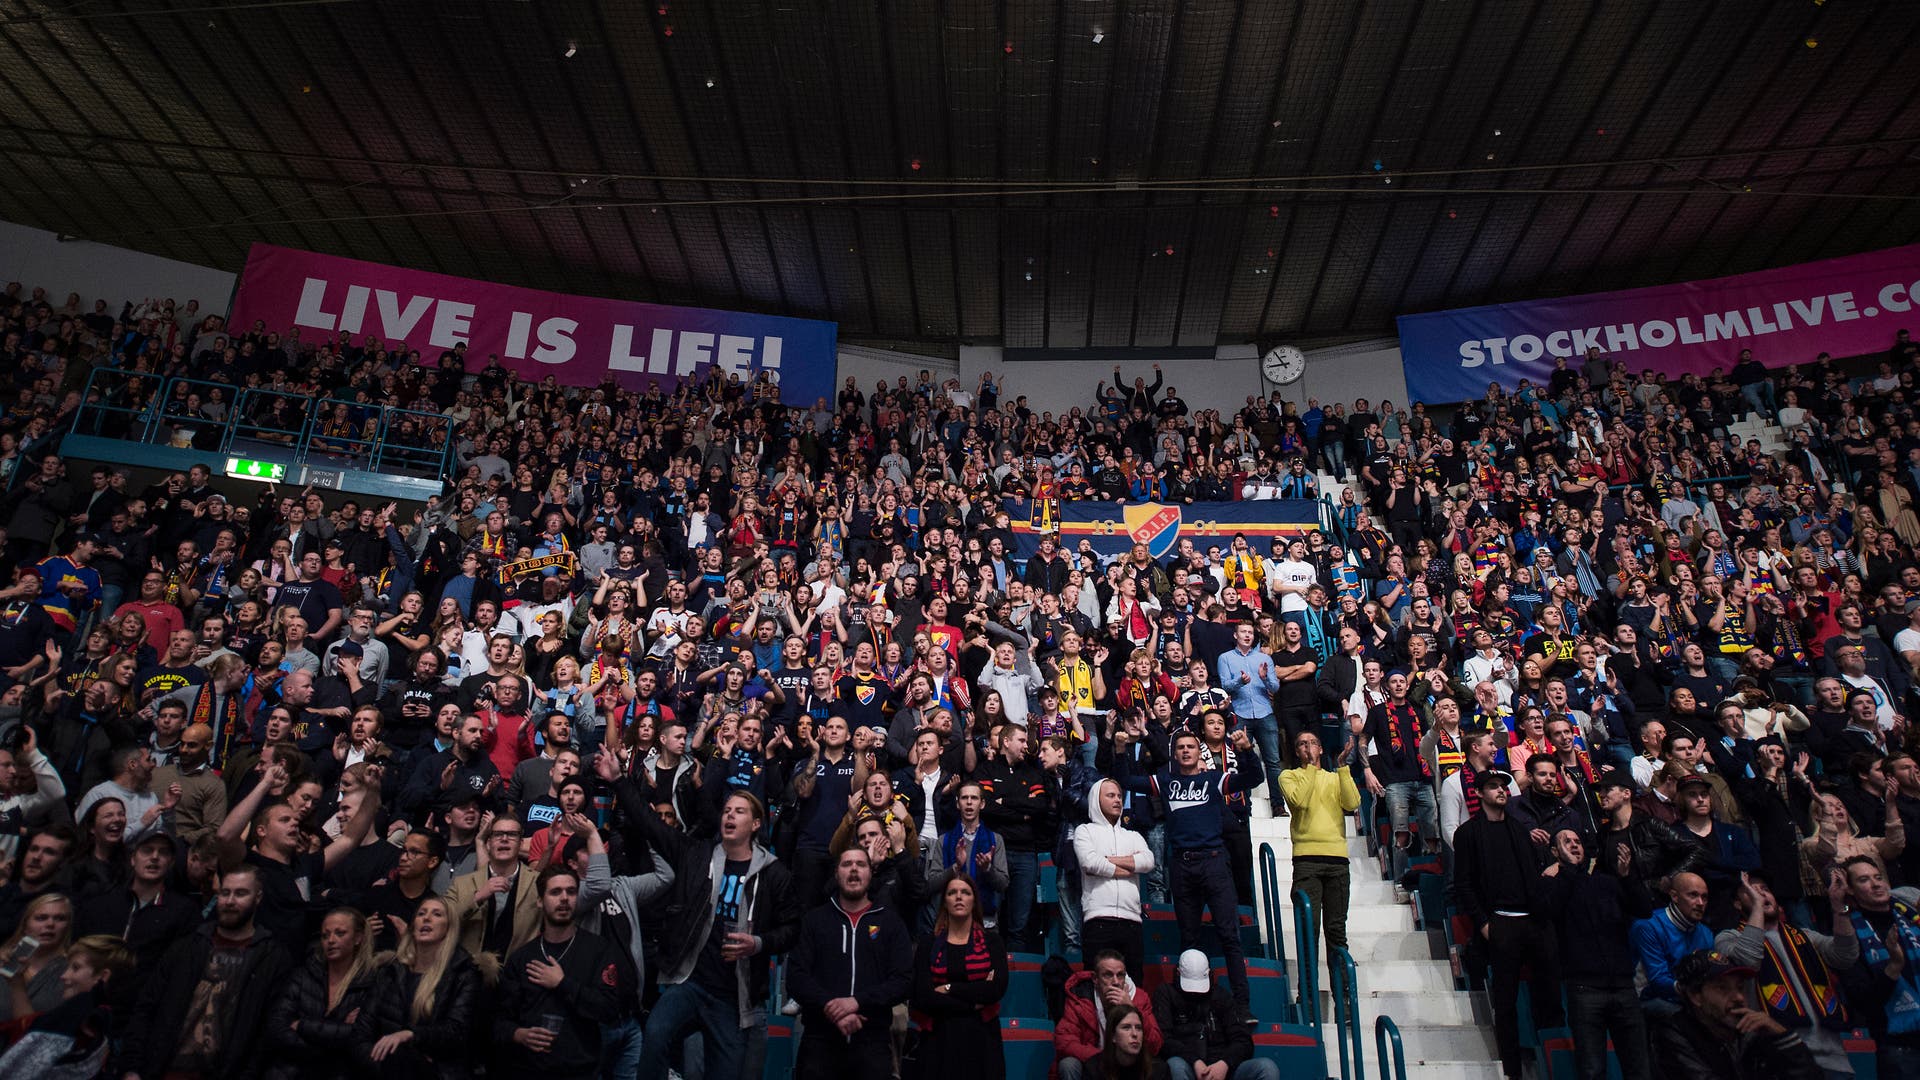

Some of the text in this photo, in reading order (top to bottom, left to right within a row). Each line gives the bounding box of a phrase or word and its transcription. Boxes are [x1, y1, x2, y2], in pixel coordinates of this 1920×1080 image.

[294, 277, 782, 384] LIVE IS LIFE!
[1091, 520, 1116, 536] 18
[1194, 520, 1220, 536] 91
[1545, 647, 1575, 659] PAY
[144, 673, 191, 689] HUMANITY
[1168, 780, 1210, 801] Rebel
[534, 809, 559, 820] sth
